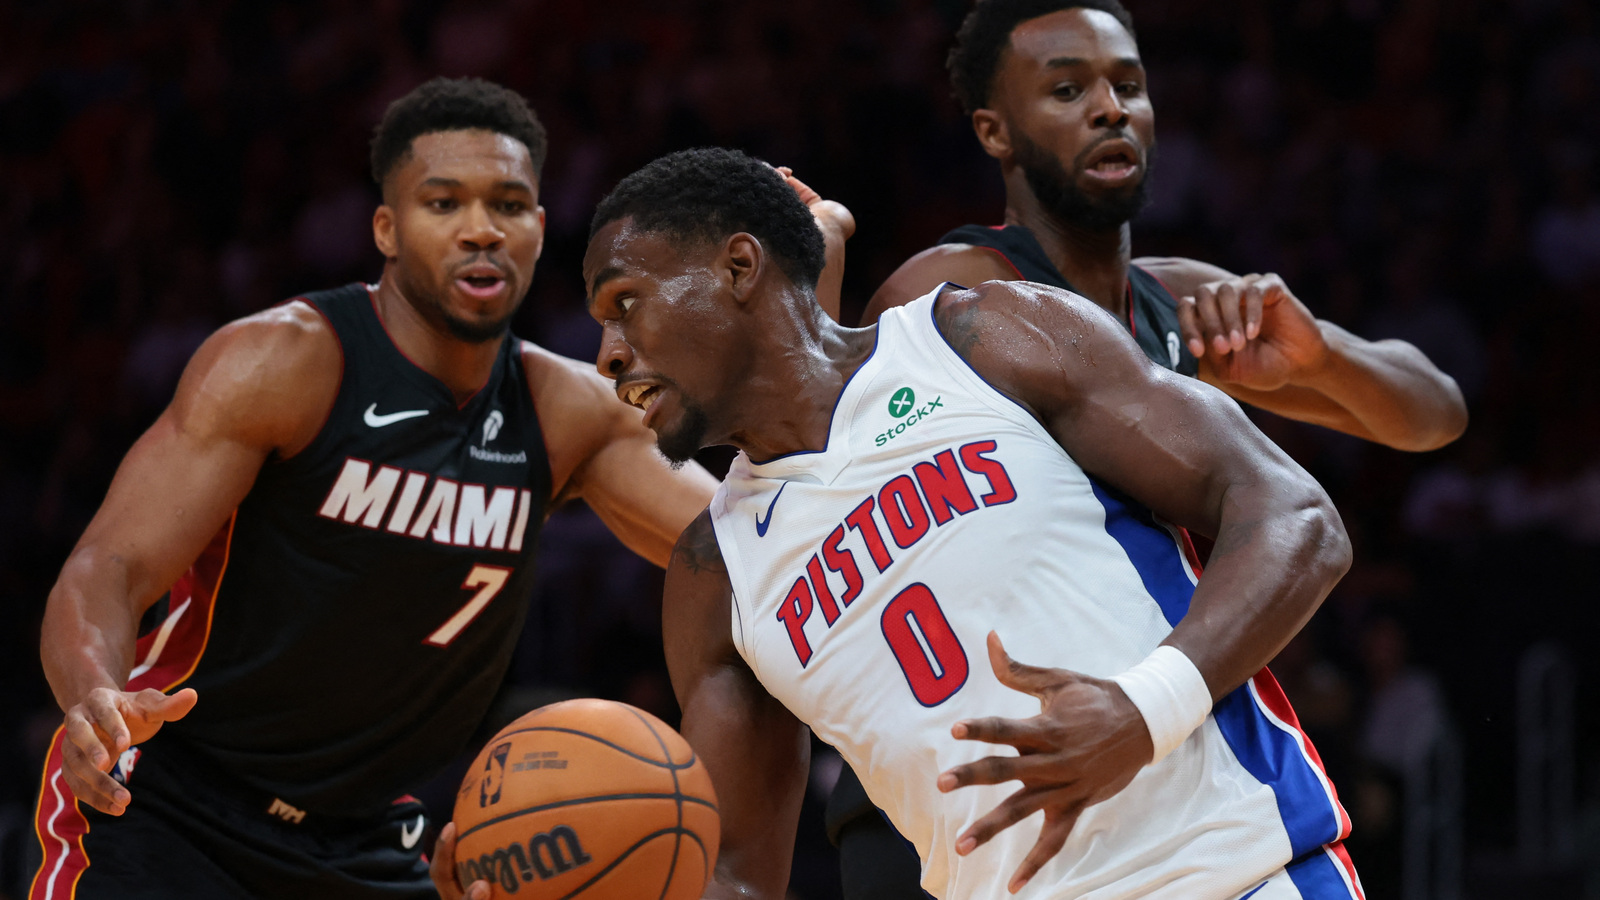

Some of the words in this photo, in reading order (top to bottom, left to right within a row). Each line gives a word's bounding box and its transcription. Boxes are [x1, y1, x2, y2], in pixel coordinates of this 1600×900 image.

[470, 445, 527, 464] Robinhood
[318, 457, 531, 552] MIAMI
[776, 439, 1018, 669] PISTONS
[421, 561, 515, 648] 7
[880, 581, 970, 708] 0
